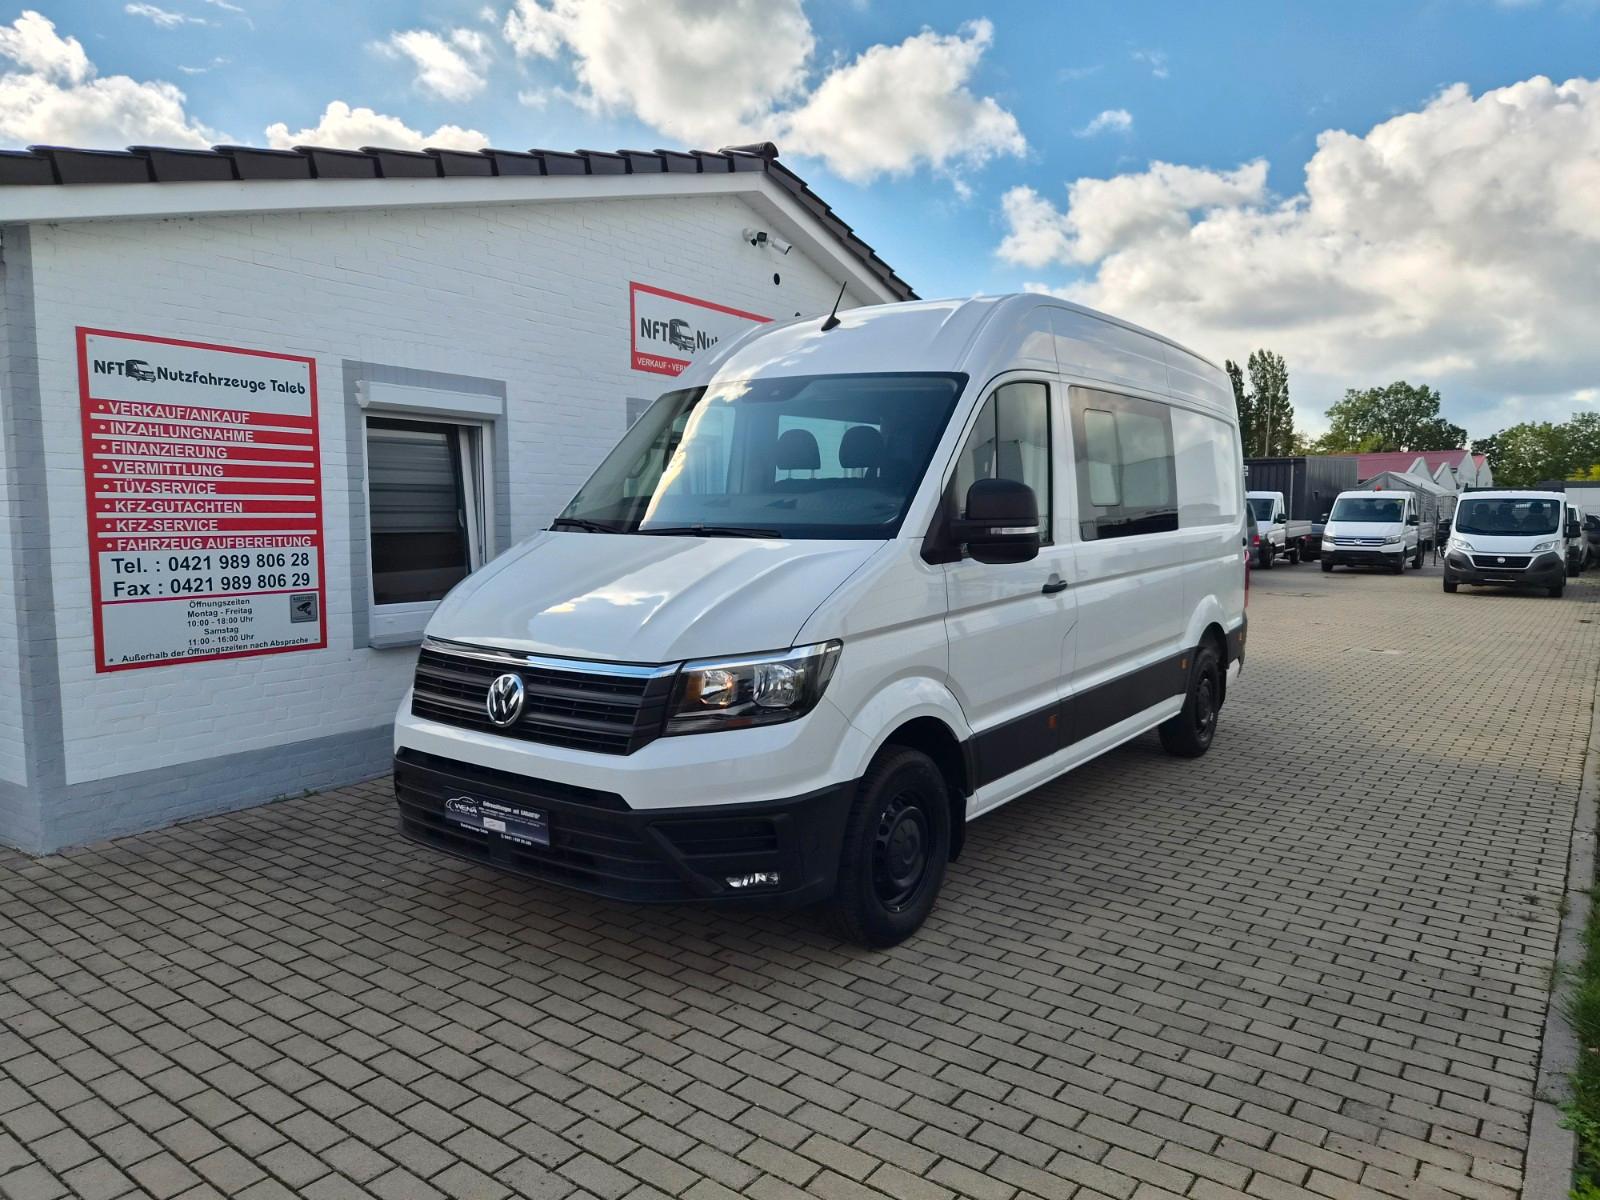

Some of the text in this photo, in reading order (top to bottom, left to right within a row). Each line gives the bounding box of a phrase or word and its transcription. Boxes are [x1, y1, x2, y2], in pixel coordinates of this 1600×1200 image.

[640, 317, 669, 342] NFT
[636, 357, 687, 373] VERKAUF VER
[93, 359, 306, 395] NFT Nutzfahrzeuge Taleb
[108, 402, 250, 424] VERKAUF/ANKAUF
[110, 422, 254, 442] INZAHLUNGNAHME
[111, 442, 228, 459] FINANZIERUNG
[112, 461, 224, 477] VERMITTLUNG
[113, 478, 216, 494] TÜV-SERVICE
[115, 501, 243, 513] KFZ-GUTACHTEN
[116, 519, 218, 532] KFZ-SERVICE
[117, 536, 311, 551] FAHRZEUG AUFBEREITUNG
[168, 555, 211, 572] 0421
[219, 554, 250, 570] 989
[256, 553, 286, 568] 806
[291, 552, 310, 567] 28
[113, 581, 151, 597] Fax
[170, 577, 213, 594] 0421
[221, 575, 252, 591] 989
[257, 573, 287, 589] 806
[292, 572, 310, 587] 29
[189, 598, 250, 608] Öffnungszeiten
[187, 610, 218, 618] Montag
[225, 607, 253, 615] Freitag
[187, 619, 209, 627] 10:00
[217, 617, 238, 625] 18:00
[204, 626, 239, 635] Samstag
[188, 637, 210, 646] 11:00
[218, 635, 238, 643] 16:00
[122, 637, 309, 663] Außerhalb der Öffnungszeiten nach Absprache
